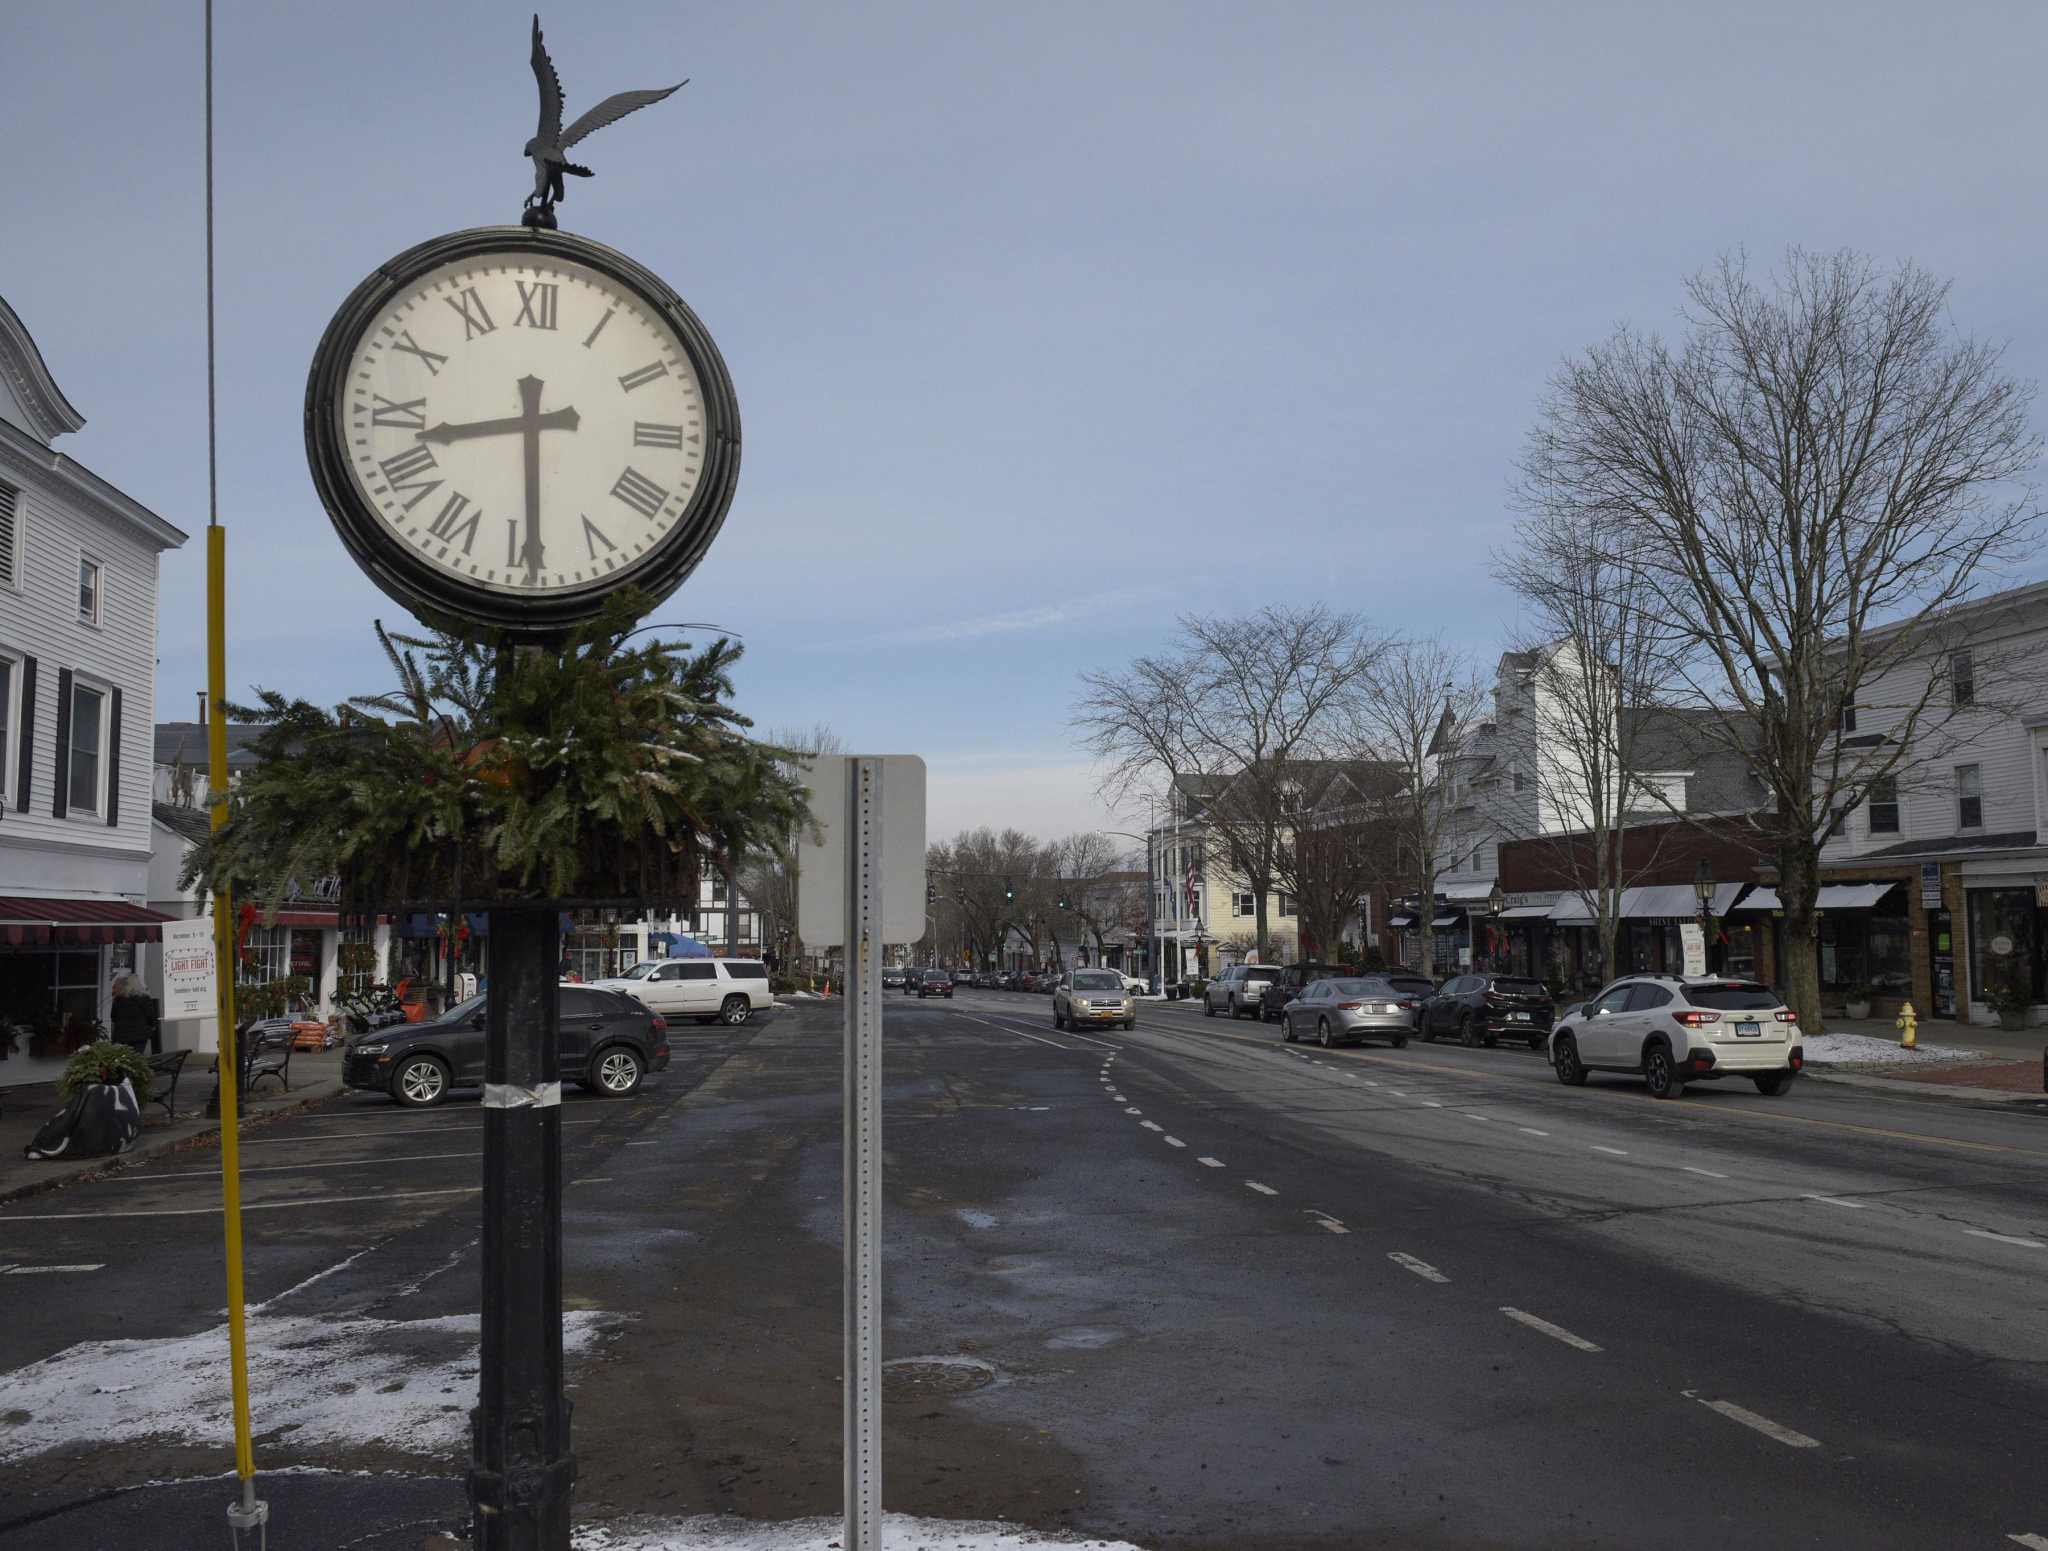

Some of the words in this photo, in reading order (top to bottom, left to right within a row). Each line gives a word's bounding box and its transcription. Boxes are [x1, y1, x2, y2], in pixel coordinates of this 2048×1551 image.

[443, 286, 497, 341] XI
[513, 280, 559, 331] XII
[582, 307, 615, 349] I
[391, 329, 448, 376] X
[618, 359, 669, 393] II
[371, 393, 427, 430] IX
[633, 420, 683, 451] III
[378, 444, 446, 513] VIII
[609, 465, 670, 521] IIII
[426, 490, 483, 557] VII
[580, 512, 618, 561] V
[171, 960, 189, 971] LIGHT
[191, 959, 209, 969] FIGHT
